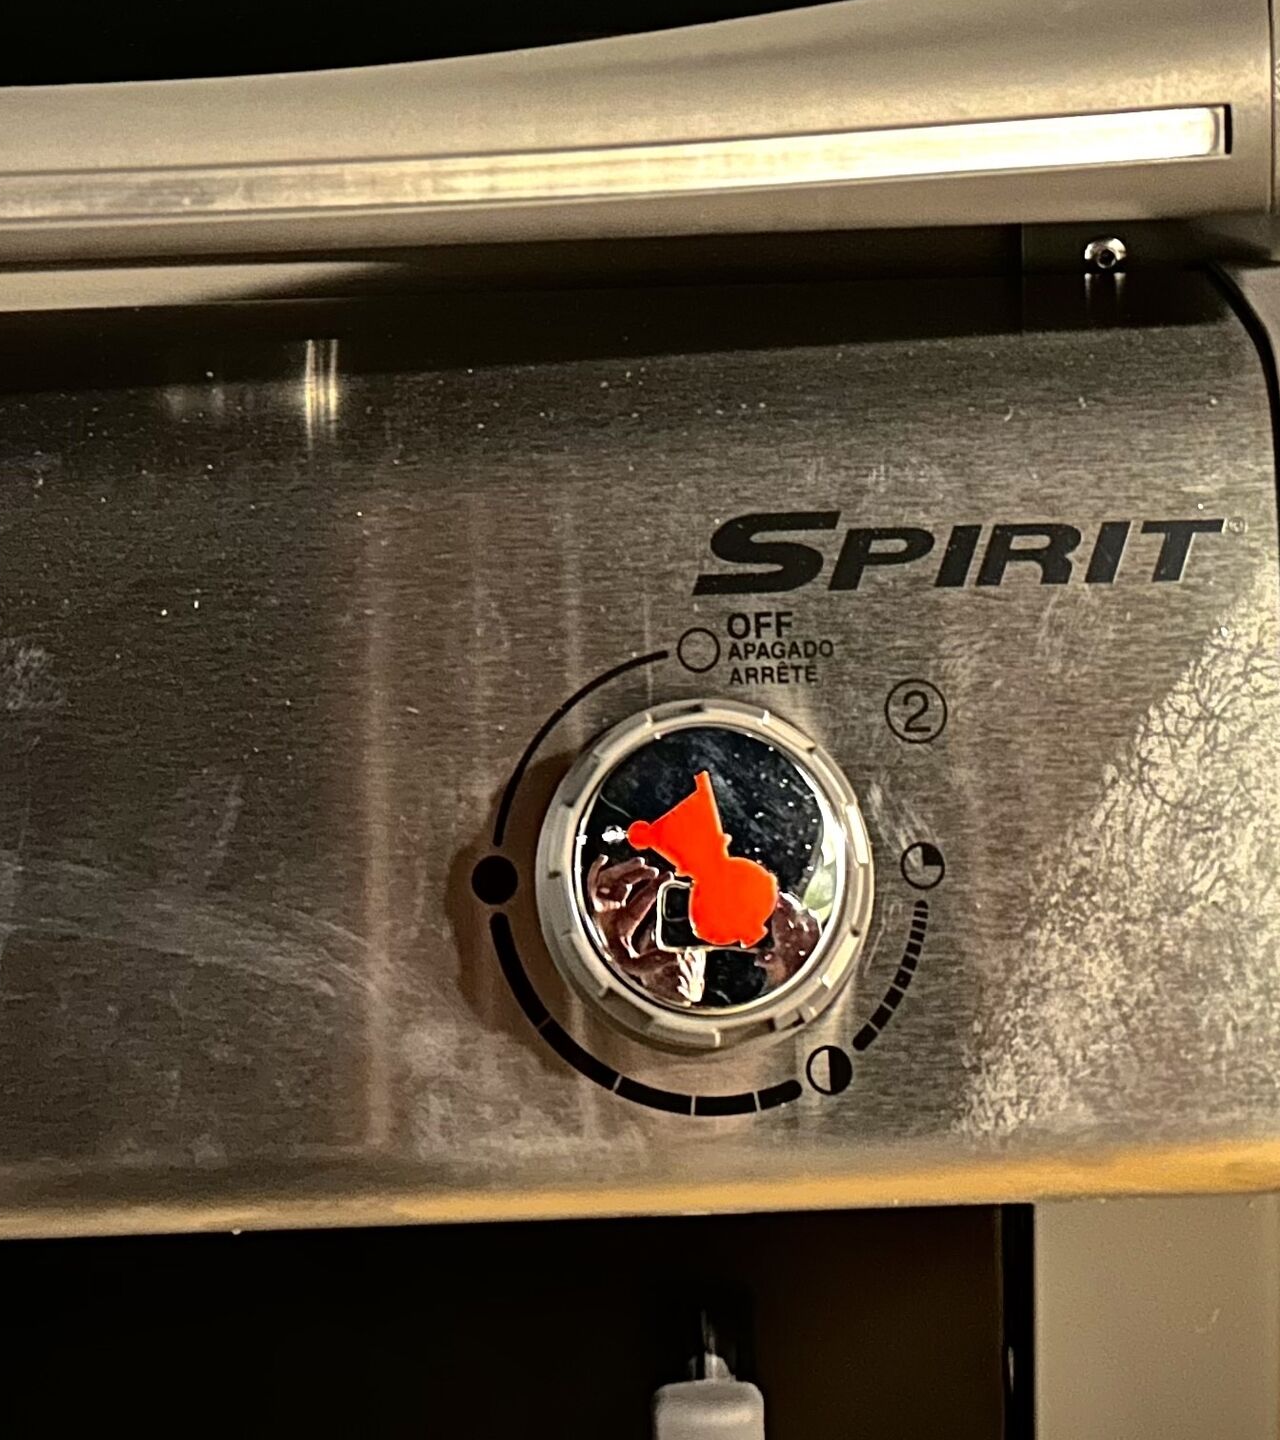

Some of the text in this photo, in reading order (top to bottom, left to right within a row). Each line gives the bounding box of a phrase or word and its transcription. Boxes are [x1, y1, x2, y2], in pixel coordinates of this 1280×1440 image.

[692, 511, 1225, 596] SPIRIT
[727, 611, 793, 639] OFF
[728, 640, 834, 660] APAGADO
